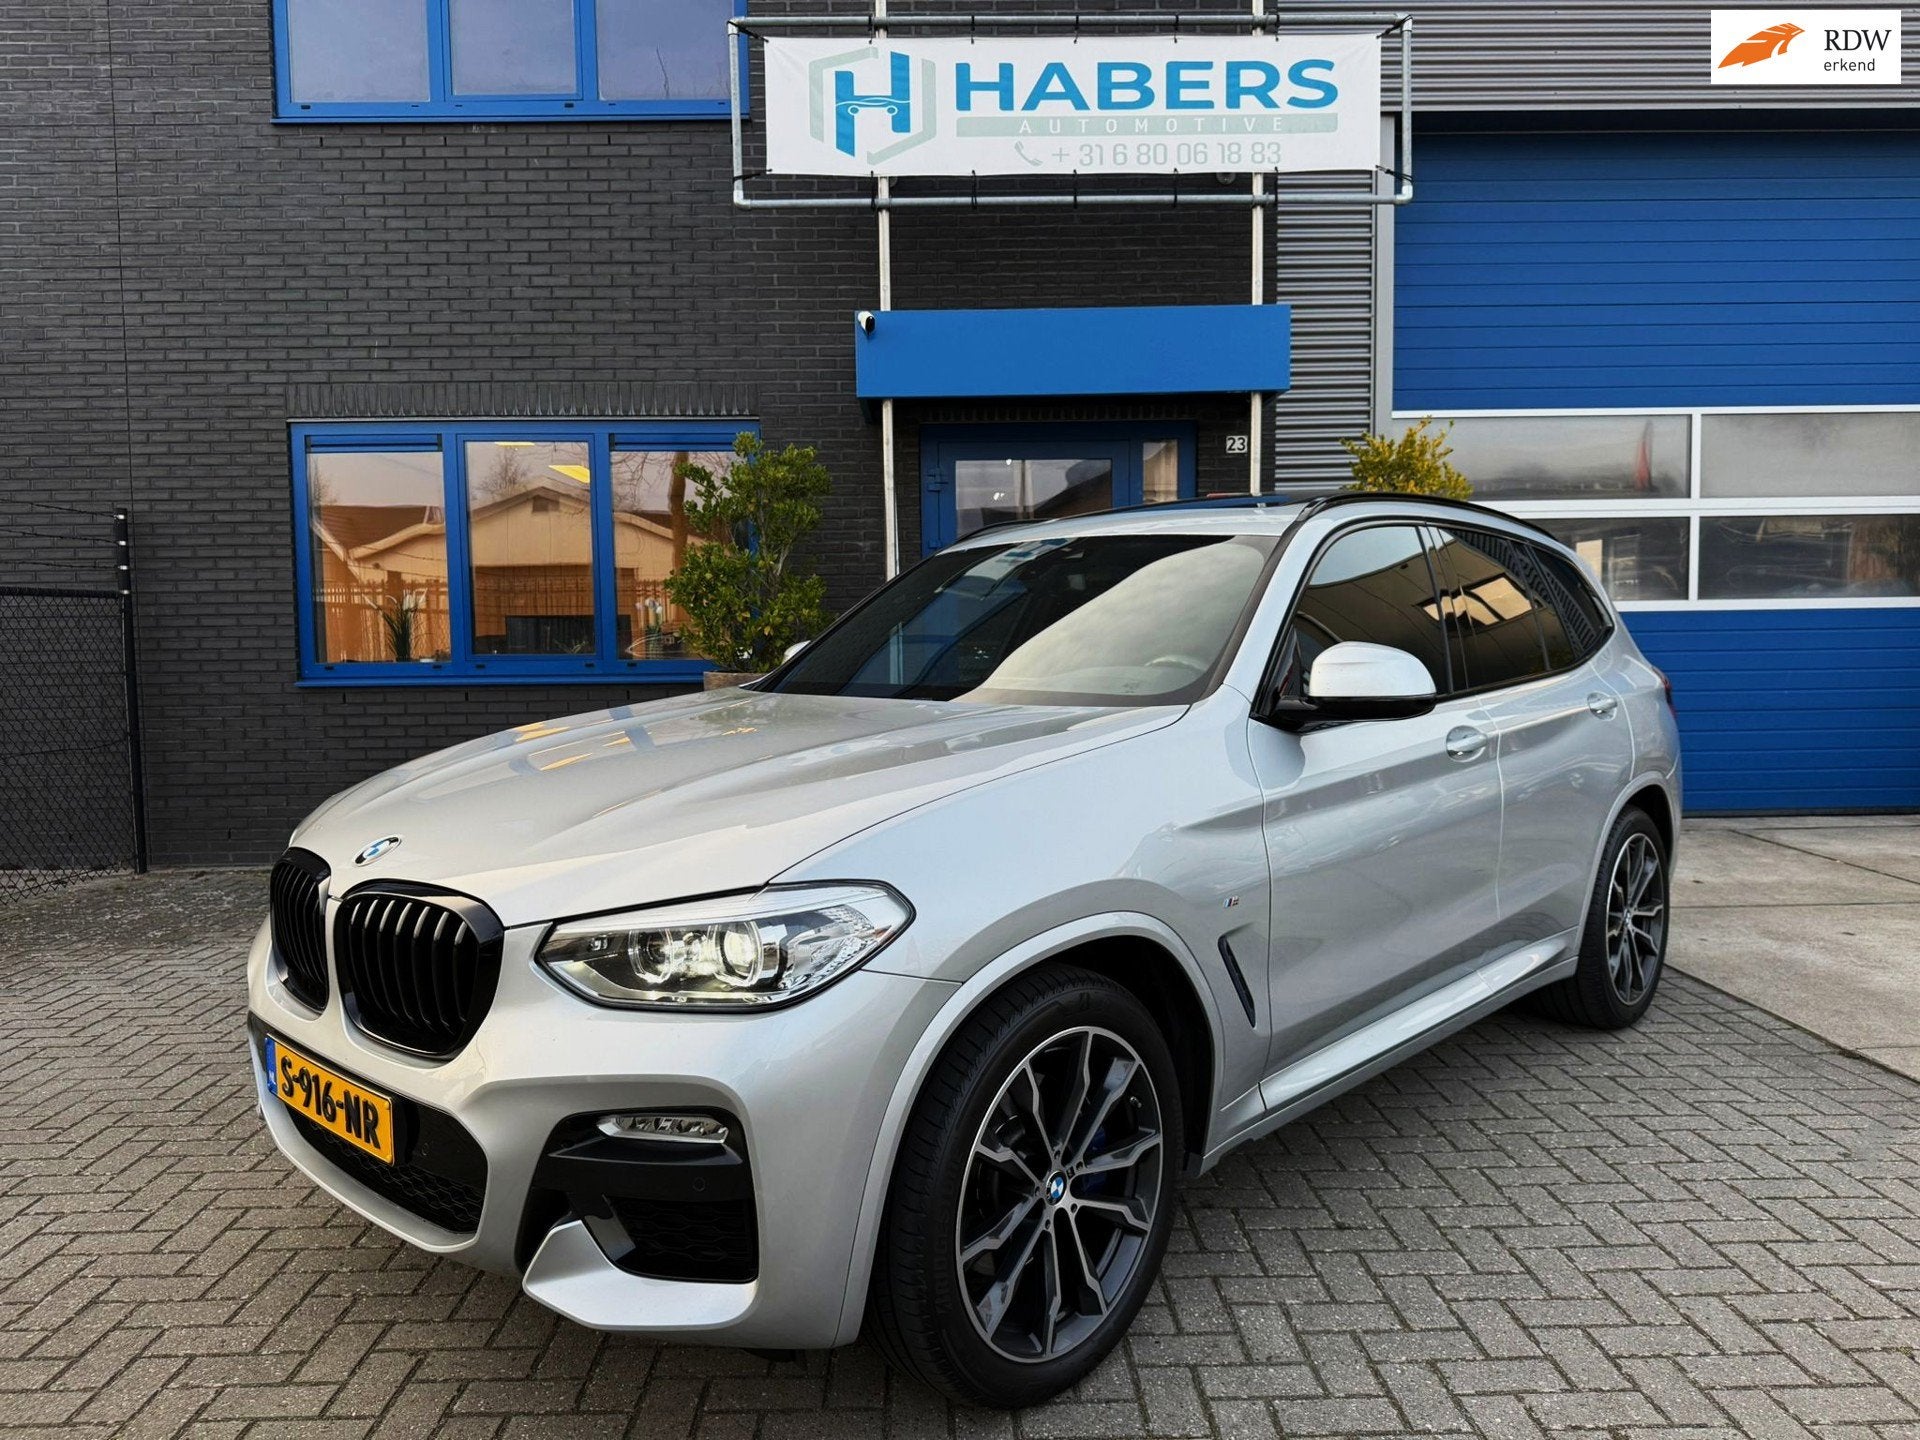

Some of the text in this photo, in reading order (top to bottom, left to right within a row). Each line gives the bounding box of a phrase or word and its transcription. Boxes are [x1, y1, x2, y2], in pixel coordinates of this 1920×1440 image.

[955, 58, 1339, 112] HABERS
[1018, 116, 1283, 135] AUTOMOTIVE
[1135, 142, 1168, 166] 80
[1176, 142, 1209, 165] 06
[1216, 141, 1242, 165] 18
[1250, 141, 1282, 164] 83
[1227, 437, 1246, 451] 23
[281, 1056, 381, 1149] S-916-NR
